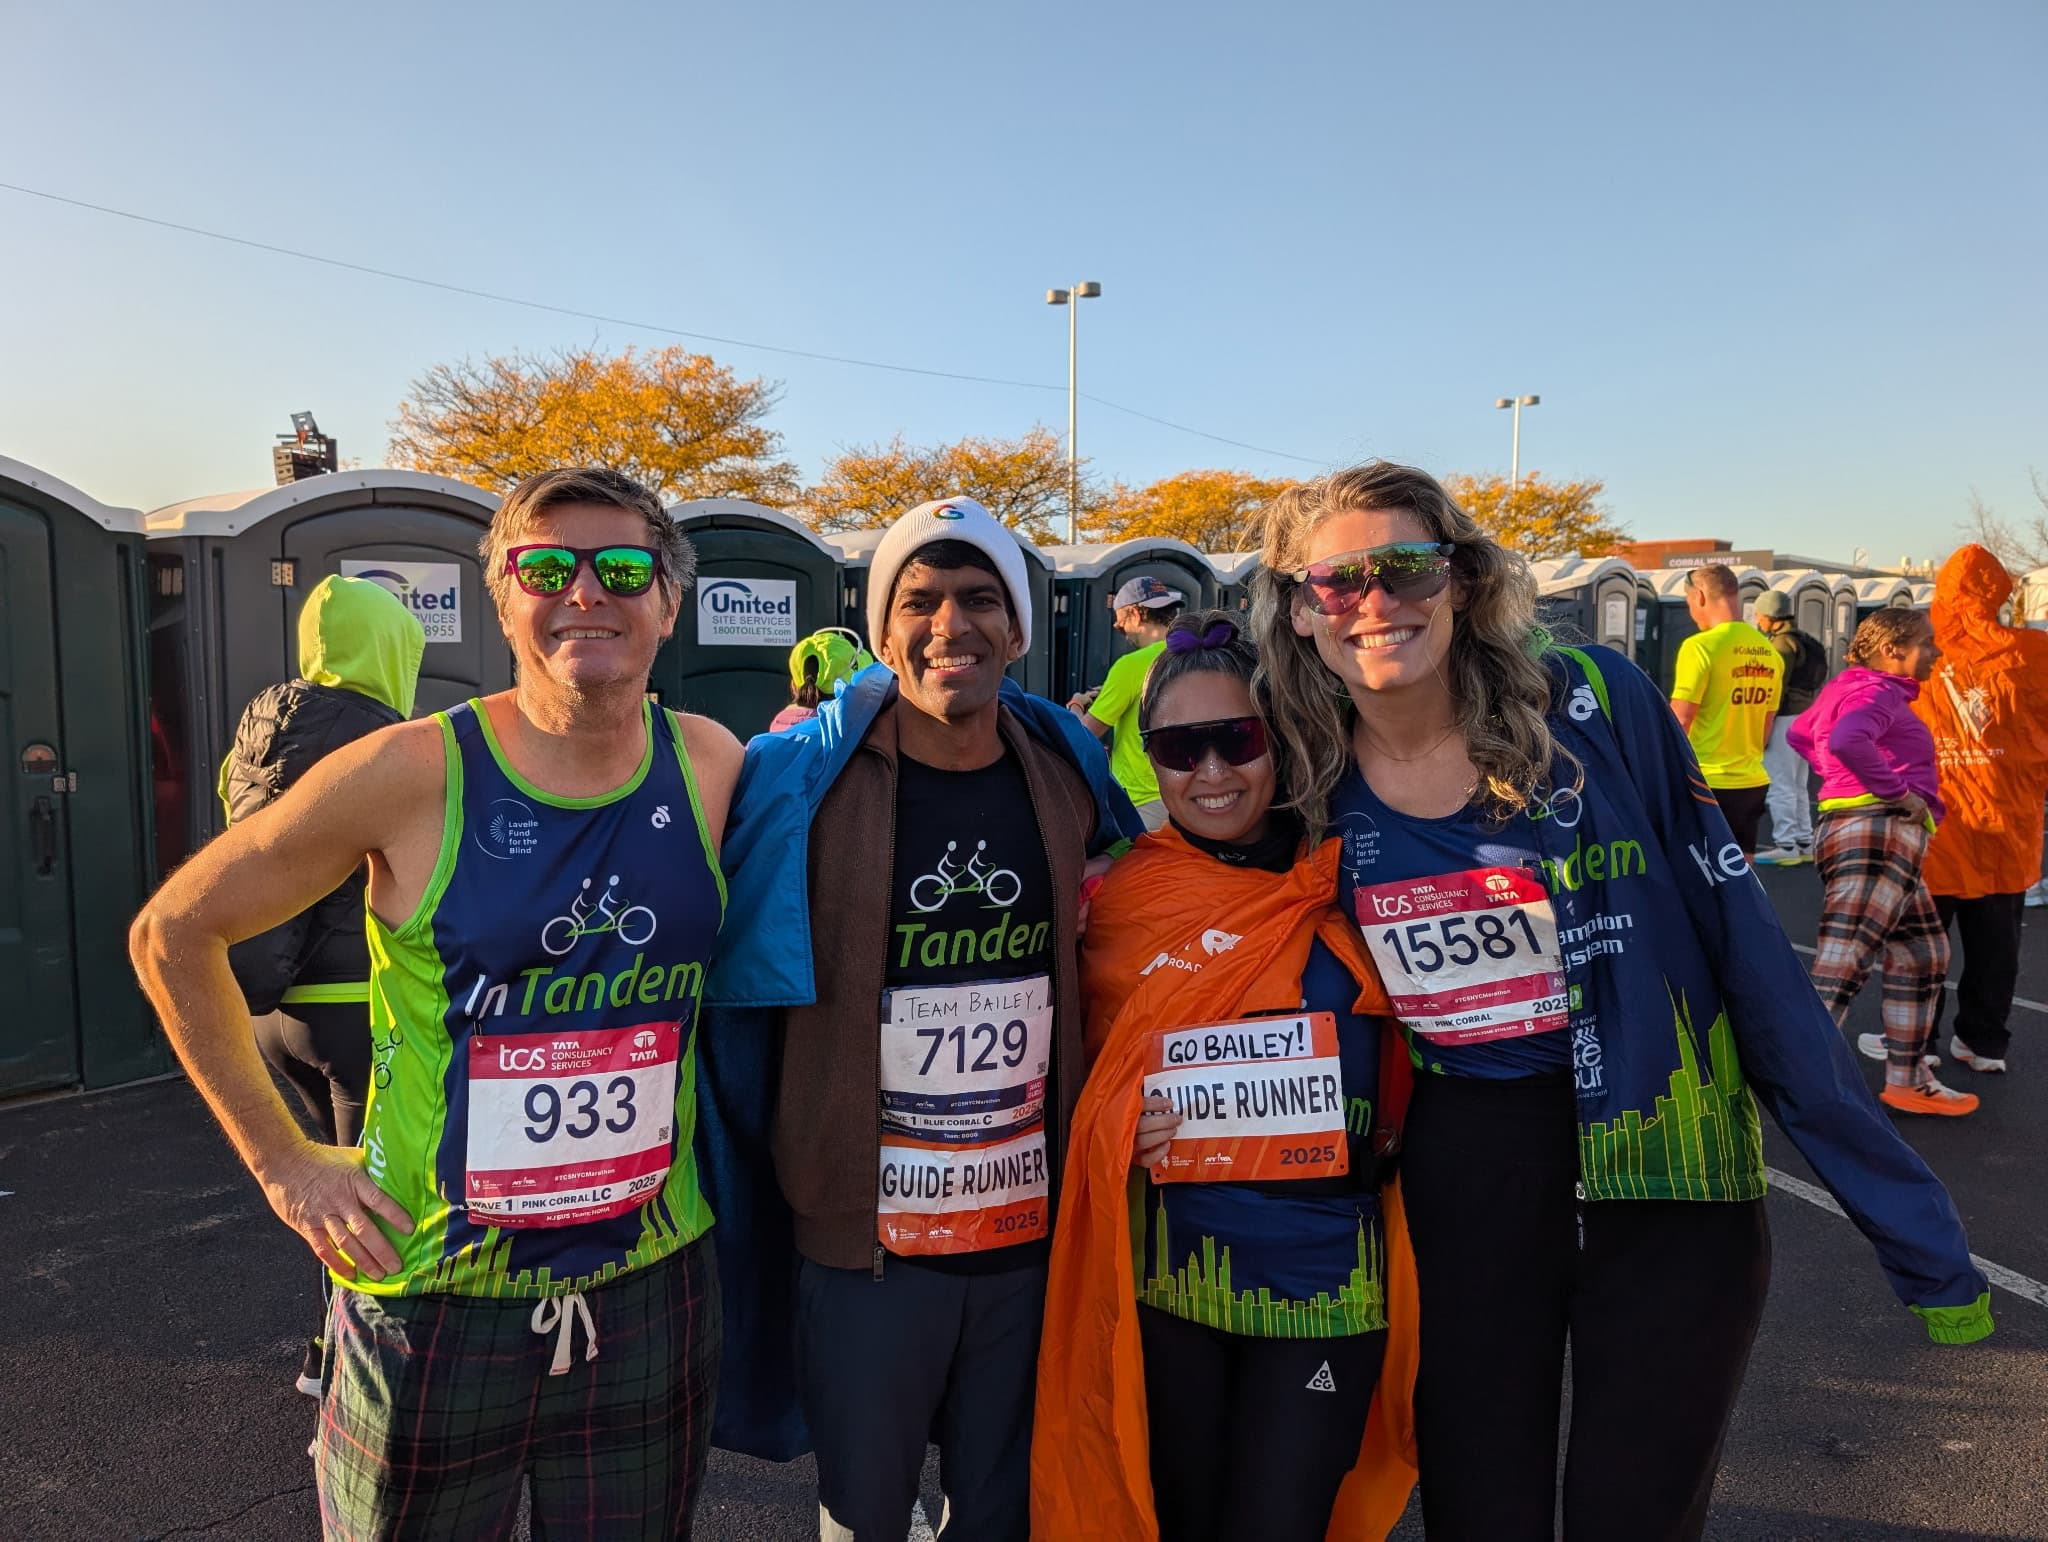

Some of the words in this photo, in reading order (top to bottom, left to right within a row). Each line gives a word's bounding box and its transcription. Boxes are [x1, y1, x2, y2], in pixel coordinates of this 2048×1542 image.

[393, 586, 456, 610] ited
[712, 593, 791, 614] United
[411, 613, 456, 624] VICES
[712, 616, 736, 625] SITE
[740, 616, 792, 626] SERVICES
[424, 625, 455, 637] 8955
[713, 626, 791, 636] 1800TOILETS.com
[508, 819, 539, 828] Lavelle
[509, 838, 522, 846] for
[523, 837, 538, 845] the
[1355, 831, 1380, 840] Lavelle
[1356, 840, 1374, 848] Fund
[1357, 857, 1375, 866] Blind
[1541, 832, 1646, 895] ndem
[1688, 836, 1751, 887] Ke
[1410, 884, 1436, 894] TATA
[1414, 888, 1469, 904] CONSULTANCY
[1486, 890, 1520, 903] TATA
[1372, 893, 1412, 918] tcs
[1417, 900, 1453, 912] SERVICES
[1382, 909, 1542, 975] 15581
[1565, 939, 1624, 973] ystem
[464, 974, 509, 1020] In
[520, 952, 703, 1015] Tandem
[905, 996, 959, 1021] TEAM
[969, 990, 1034, 1013] BAILEY
[1532, 996, 1569, 1014] 2025
[1434, 1019, 1454, 1028] PINK
[1455, 1013, 1493, 1026] CORRAL
[1524, 1020, 1535, 1032] B
[551, 1041, 580, 1050] TATA
[916, 1019, 1028, 1076] 7129
[1168, 1039, 1198, 1064] GO
[1204, 1021, 1305, 1061] BAILEY!
[499, 1043, 546, 1072] tcs
[551, 1046, 613, 1061] CONSULTANCY
[629, 1050, 659, 1062] TATA
[551, 1060, 592, 1071] SERVICES
[1234, 1074, 1339, 1119] RUNNER
[524, 1075, 637, 1143] 933
[1012, 1102, 1037, 1119] 2025
[910, 1116, 917, 1126] 1
[923, 1118, 945, 1126] BLUE
[947, 1118, 981, 1126] CORRAL
[983, 1115, 993, 1126] C
[1280, 1145, 1336, 1165] 2025
[882, 1162, 955, 1199] GUIDE
[961, 1148, 1046, 1195] RUNNER
[628, 1174, 657, 1194] 2025
[471, 1201, 502, 1210] WAVE
[505, 1199, 513, 1211] 1
[522, 1198, 546, 1209] PINK
[548, 1194, 591, 1206] CORRAL
[592, 1187, 612, 1202] LC
[994, 1210, 1040, 1234] 2025
